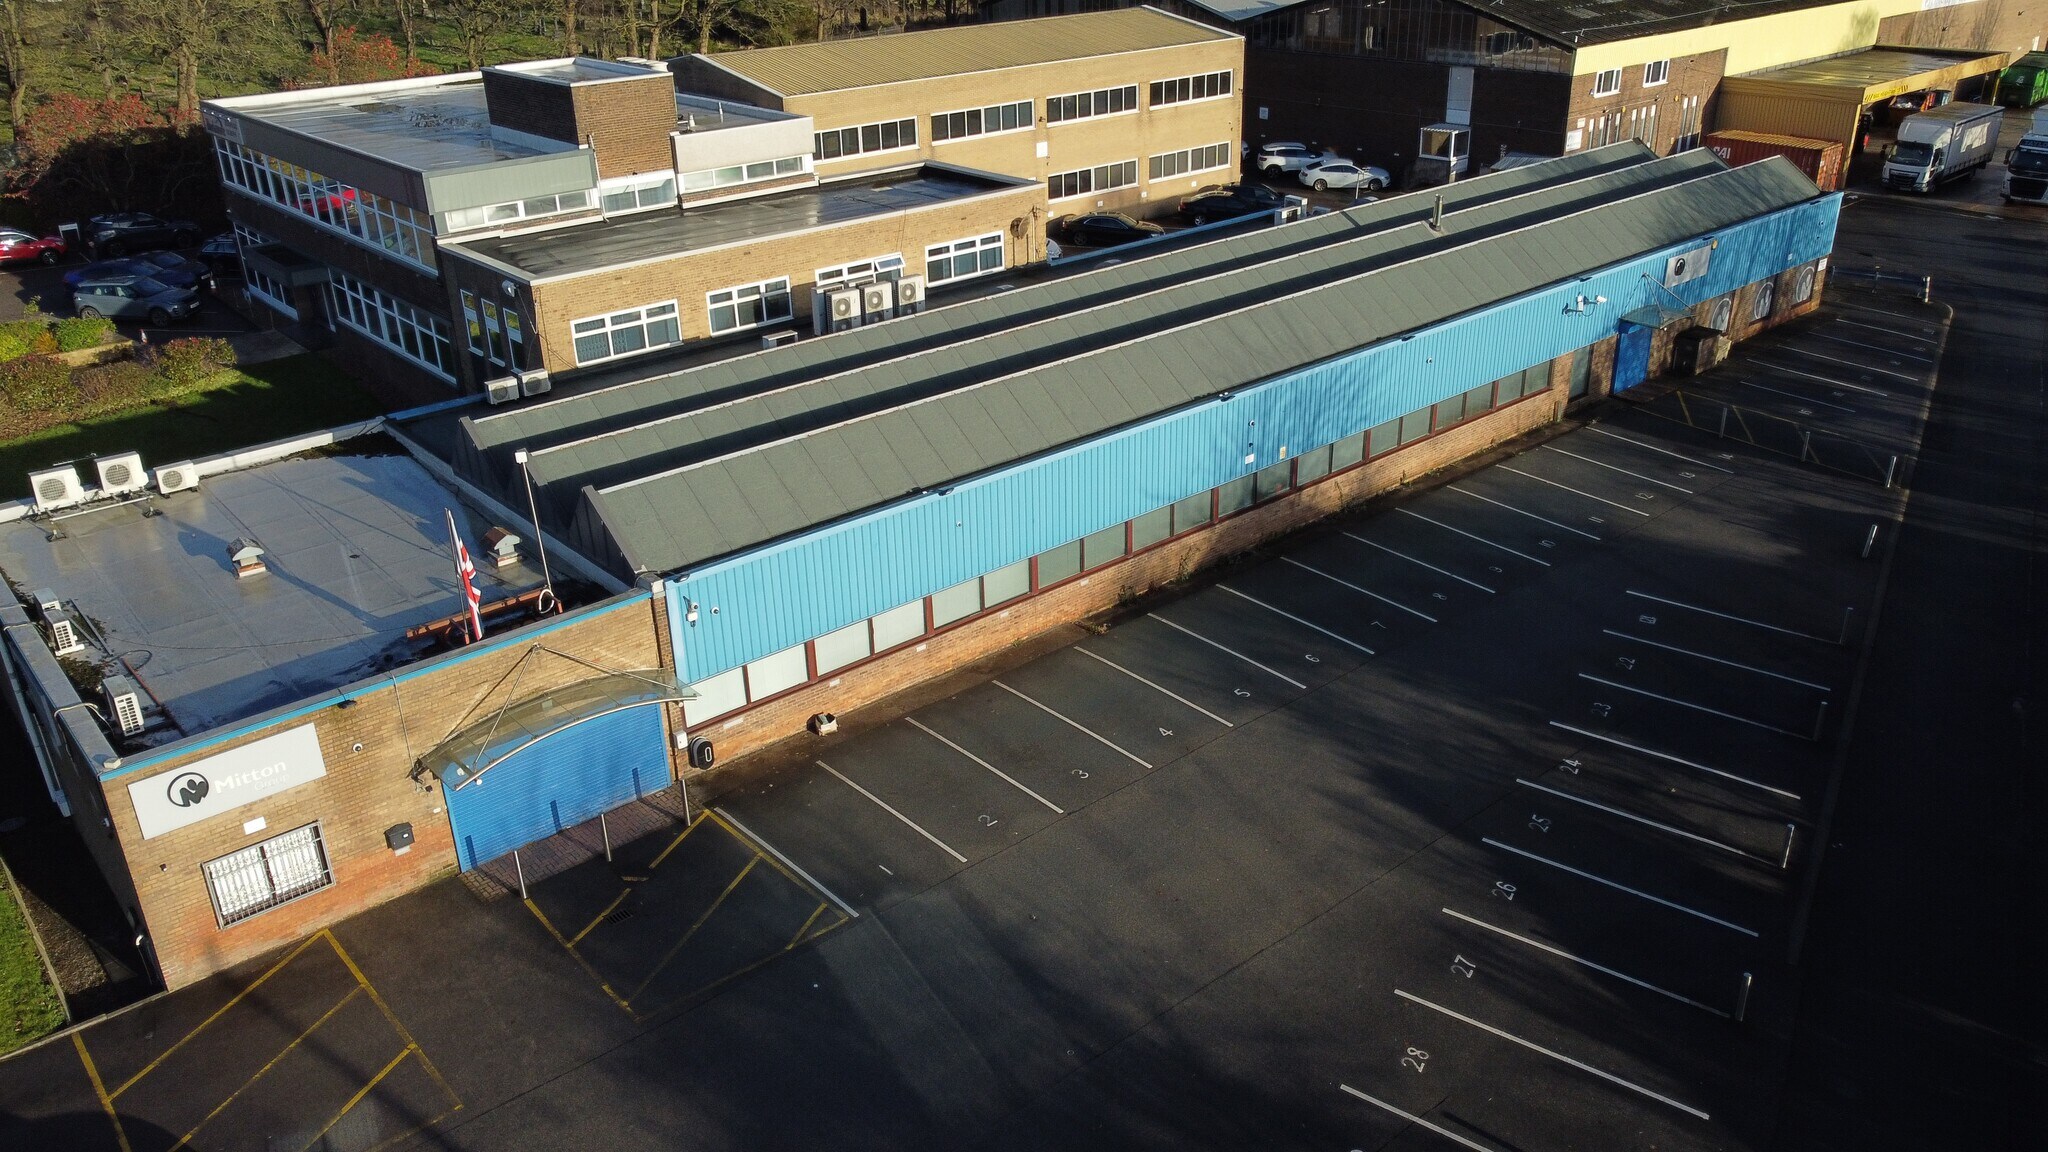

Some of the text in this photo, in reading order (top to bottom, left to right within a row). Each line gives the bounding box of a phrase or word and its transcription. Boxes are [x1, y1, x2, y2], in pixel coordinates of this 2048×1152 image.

[1234, 689, 1250, 697] 5
[1592, 703, 1611, 717] 23
[1159, 728, 1173, 736] 4
[1072, 770, 1089, 778] 3
[1560, 759, 1581, 774] 24
[214, 761, 287, 793] Mitton
[254, 773, 290, 791] Group
[978, 815, 998, 826] 2
[1529, 814, 1550, 832] 25
[1491, 881, 1516, 900] 26
[1451, 955, 1476, 978] 27
[1401, 1047, 1429, 1073] 28
